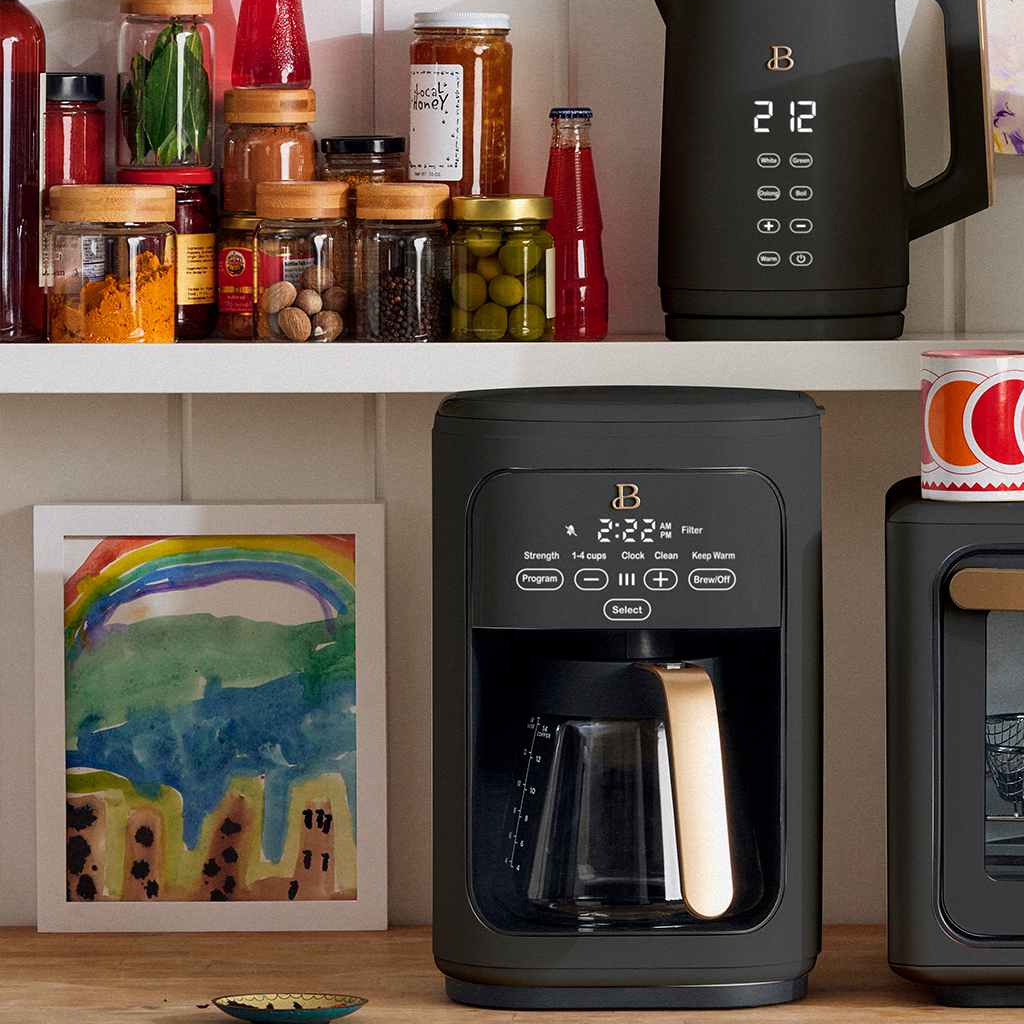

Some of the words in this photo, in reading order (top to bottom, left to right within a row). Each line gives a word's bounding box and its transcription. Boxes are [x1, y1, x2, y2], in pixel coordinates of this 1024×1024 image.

[766, 46, 795, 71] B
[760, 190, 779, 198] Oolong
[612, 483, 641, 510] B
[597, 519, 656, 543] 2:22
[681, 526, 703, 534] Filter
[660, 531, 672, 539] PM
[524, 551, 560, 562] Strength
[572, 551, 585, 560] 1-4
[587, 553, 607, 562] cups
[621, 551, 645, 560] Clock
[654, 551, 679, 560] Clean
[692, 551, 712, 562] Keep
[713, 551, 736, 560] Warm
[522, 575, 558, 585] Program
[693, 575, 731, 584] Brew/Off
[612, 606, 643, 615] Select
[535, 755, 542, 763] 12
[529, 787, 536, 795] 10
